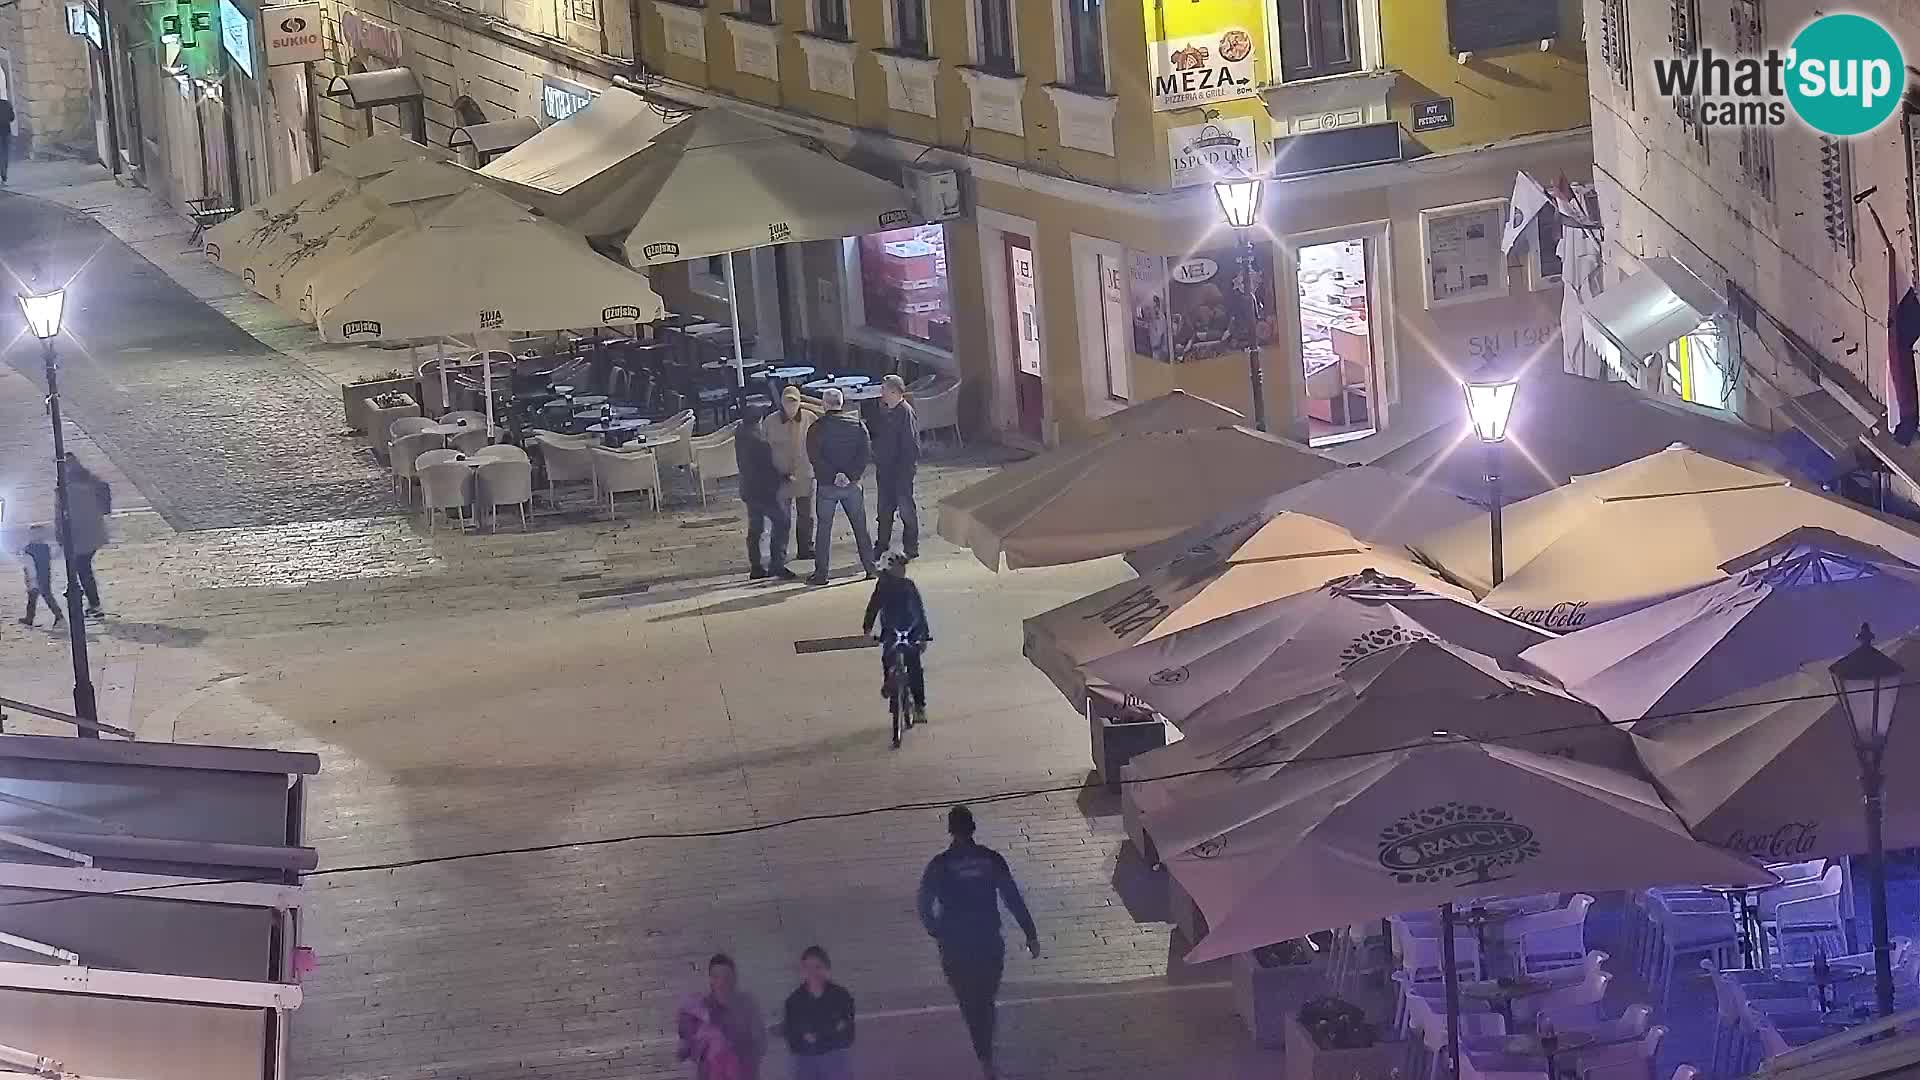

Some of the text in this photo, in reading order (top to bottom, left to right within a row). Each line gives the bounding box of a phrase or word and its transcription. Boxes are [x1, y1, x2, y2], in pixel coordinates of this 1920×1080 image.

[272, 34, 317, 48] SUKNO
[1155, 66, 1235, 97] MEZA
[1164, 92, 1198, 105] PIZZERIA
[1205, 88, 1226, 99] GRILL
[1421, 830, 1517, 858] RAUCH
